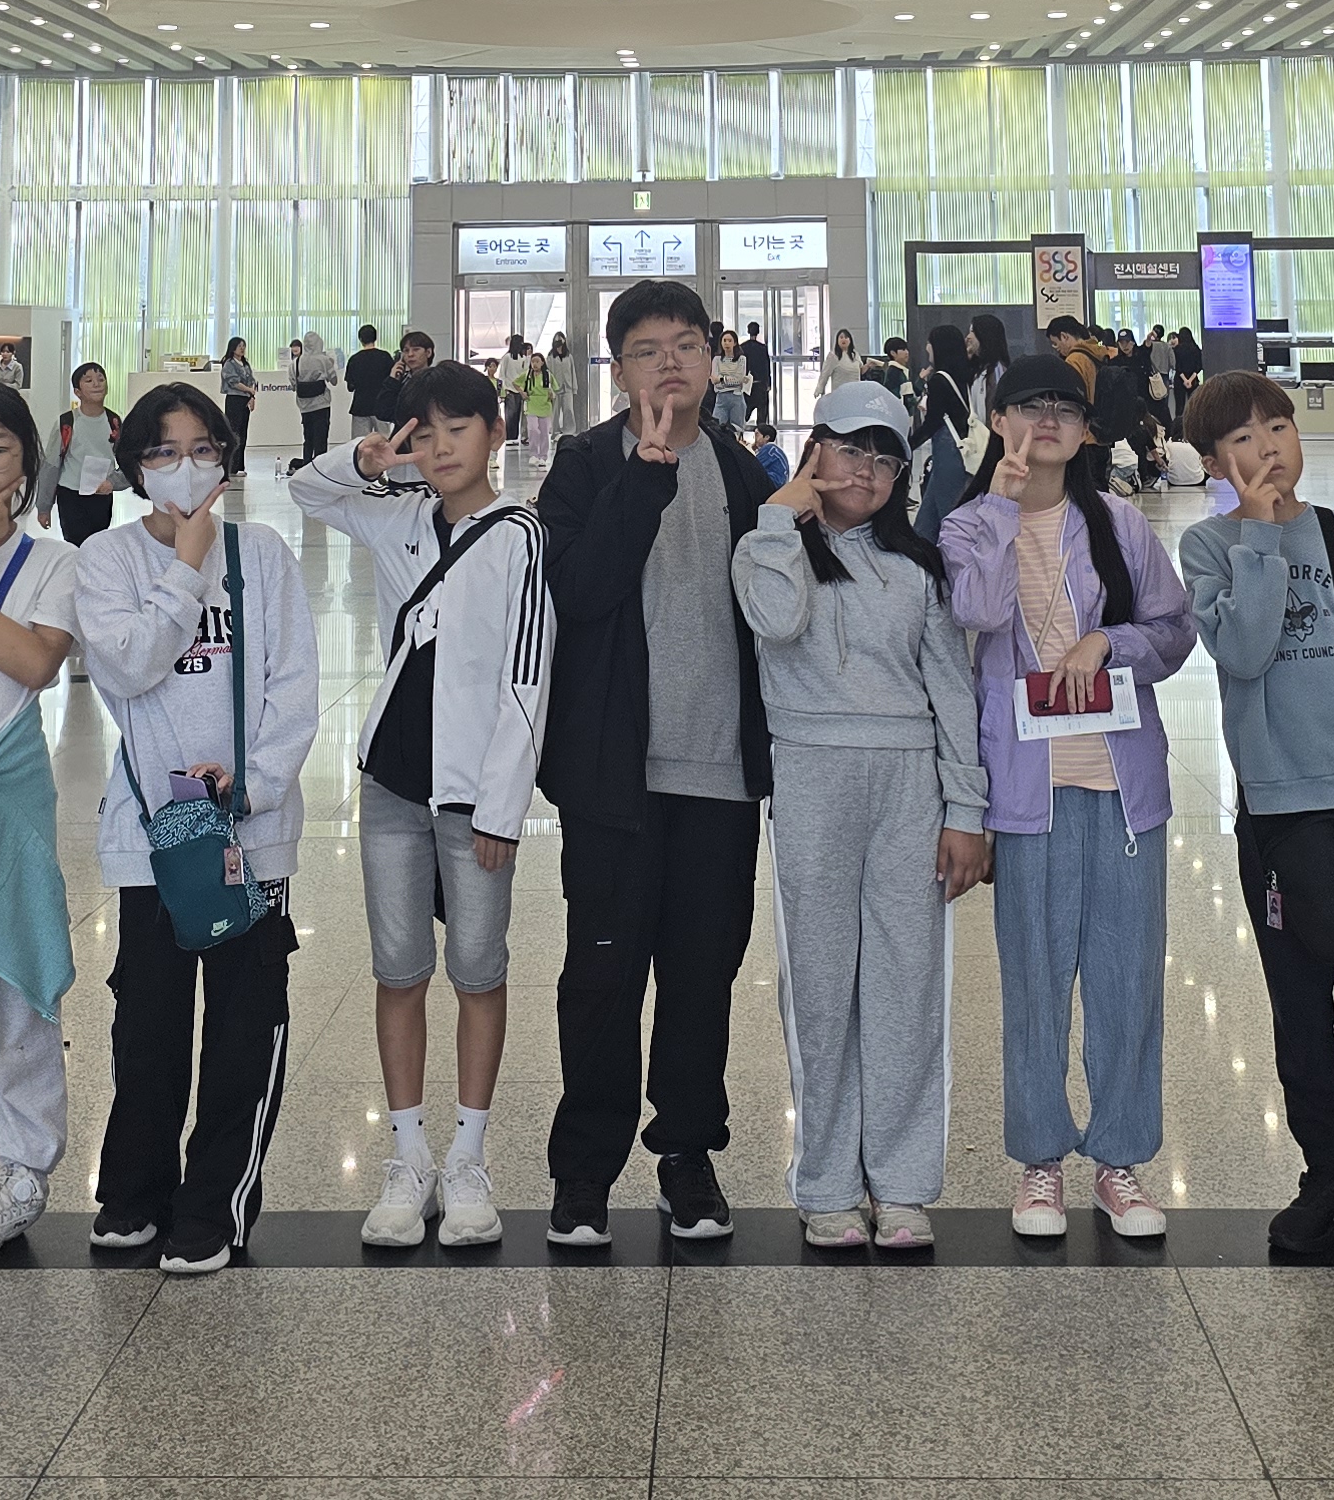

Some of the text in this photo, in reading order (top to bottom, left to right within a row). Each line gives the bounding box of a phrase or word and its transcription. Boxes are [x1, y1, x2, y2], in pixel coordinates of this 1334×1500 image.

[475, 238, 550, 254] 들어오는 곳
[743, 234, 804, 250] 나가는 곳
[495, 257, 528, 265] Entrance
[1113, 262, 1180, 276] 전시해설센터
[182, 657, 204, 672] 75
